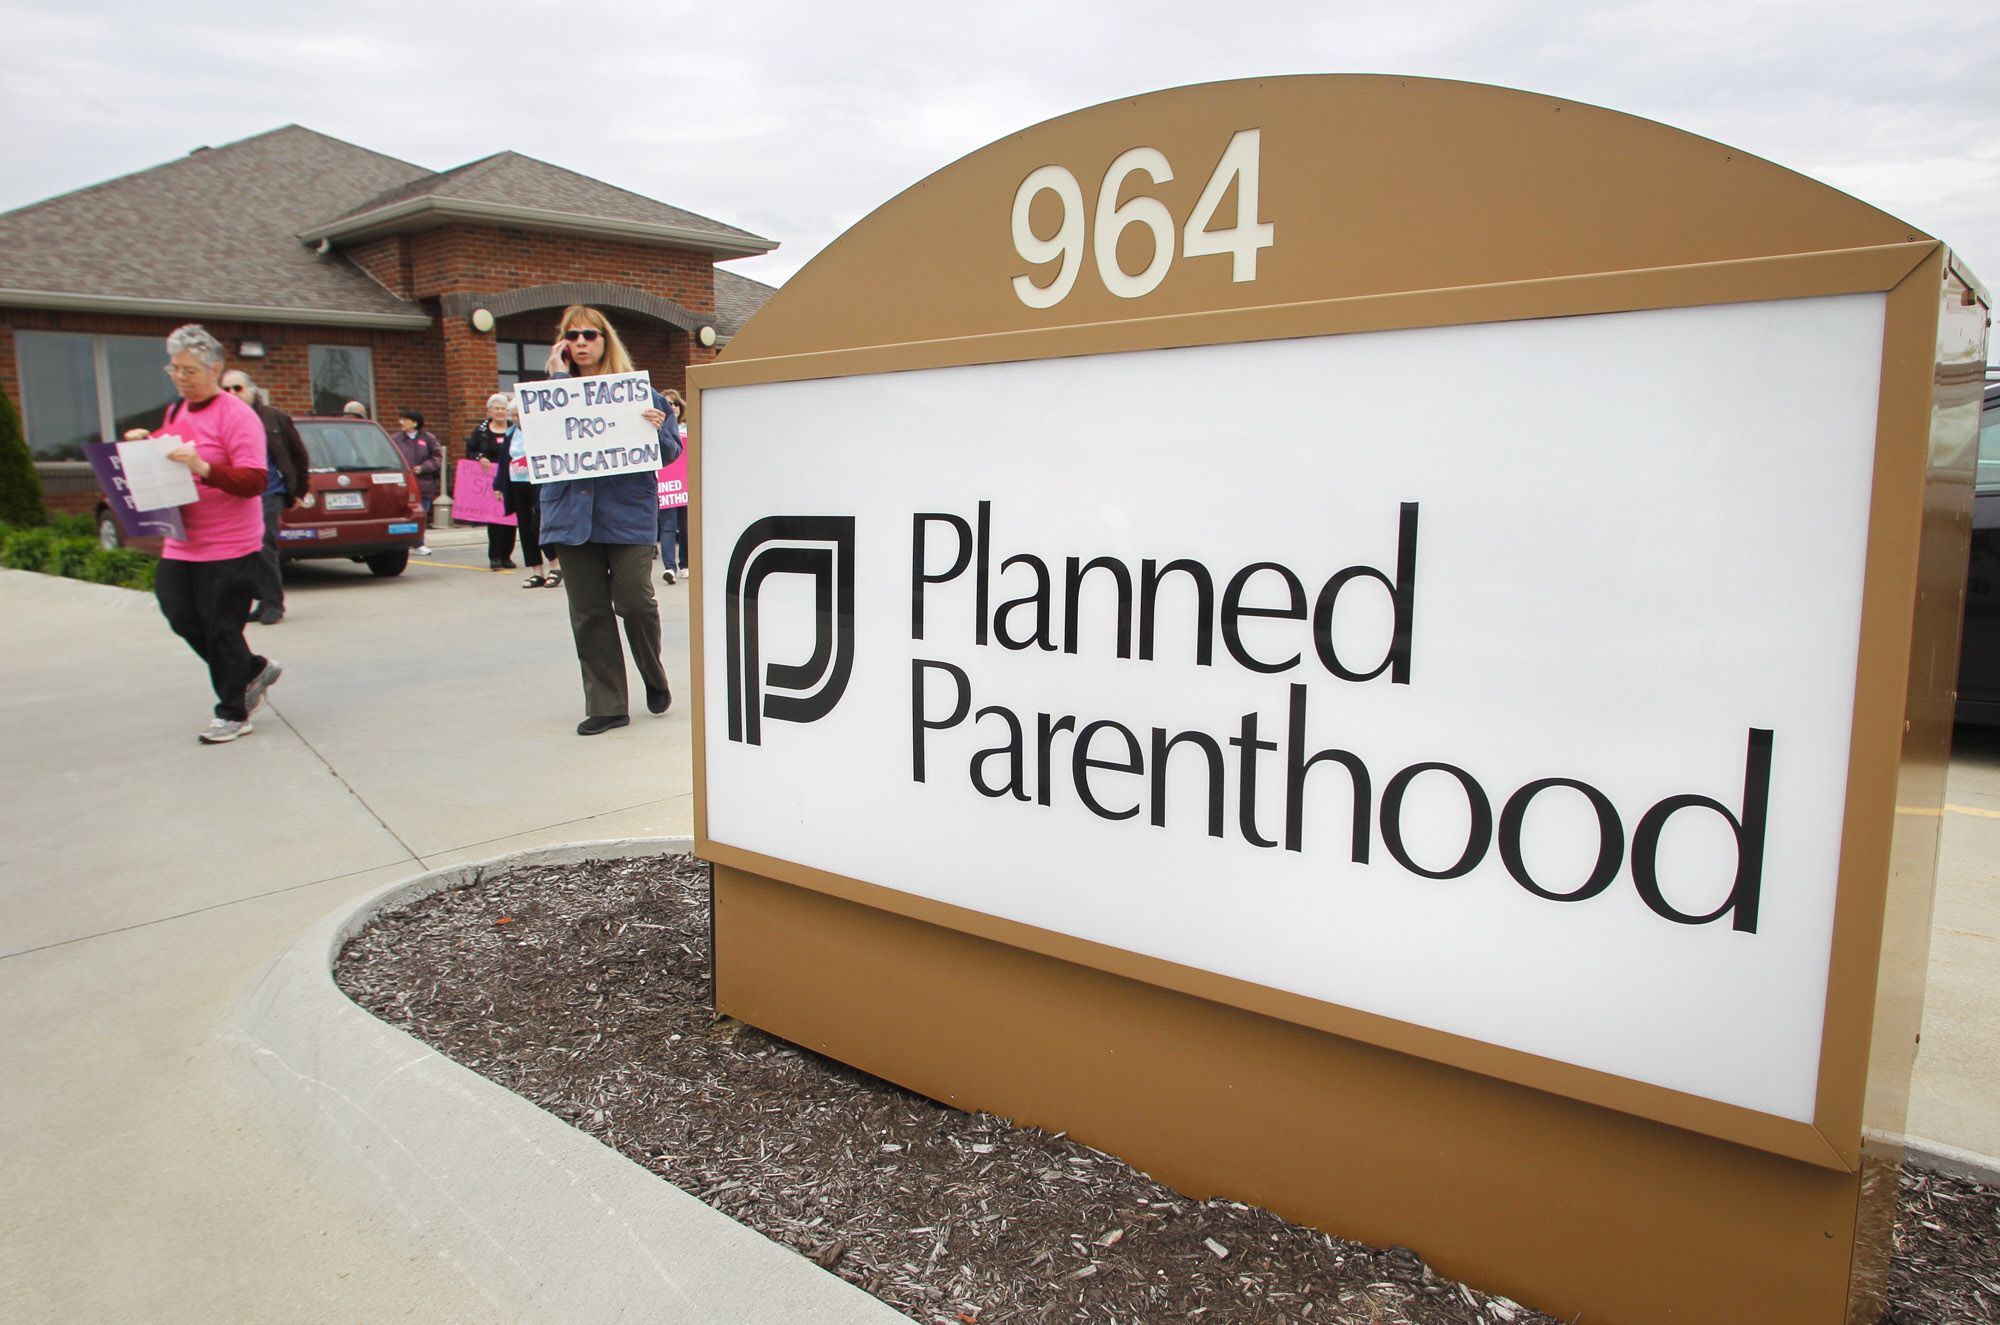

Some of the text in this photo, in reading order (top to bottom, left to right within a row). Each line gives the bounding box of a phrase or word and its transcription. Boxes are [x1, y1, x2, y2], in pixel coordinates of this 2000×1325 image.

[1011, 127, 1274, 309] 964
[565, 416, 616, 440] PRO-
[911, 501, 1419, 686] Planned
[911, 658, 1774, 935] Parenthood
